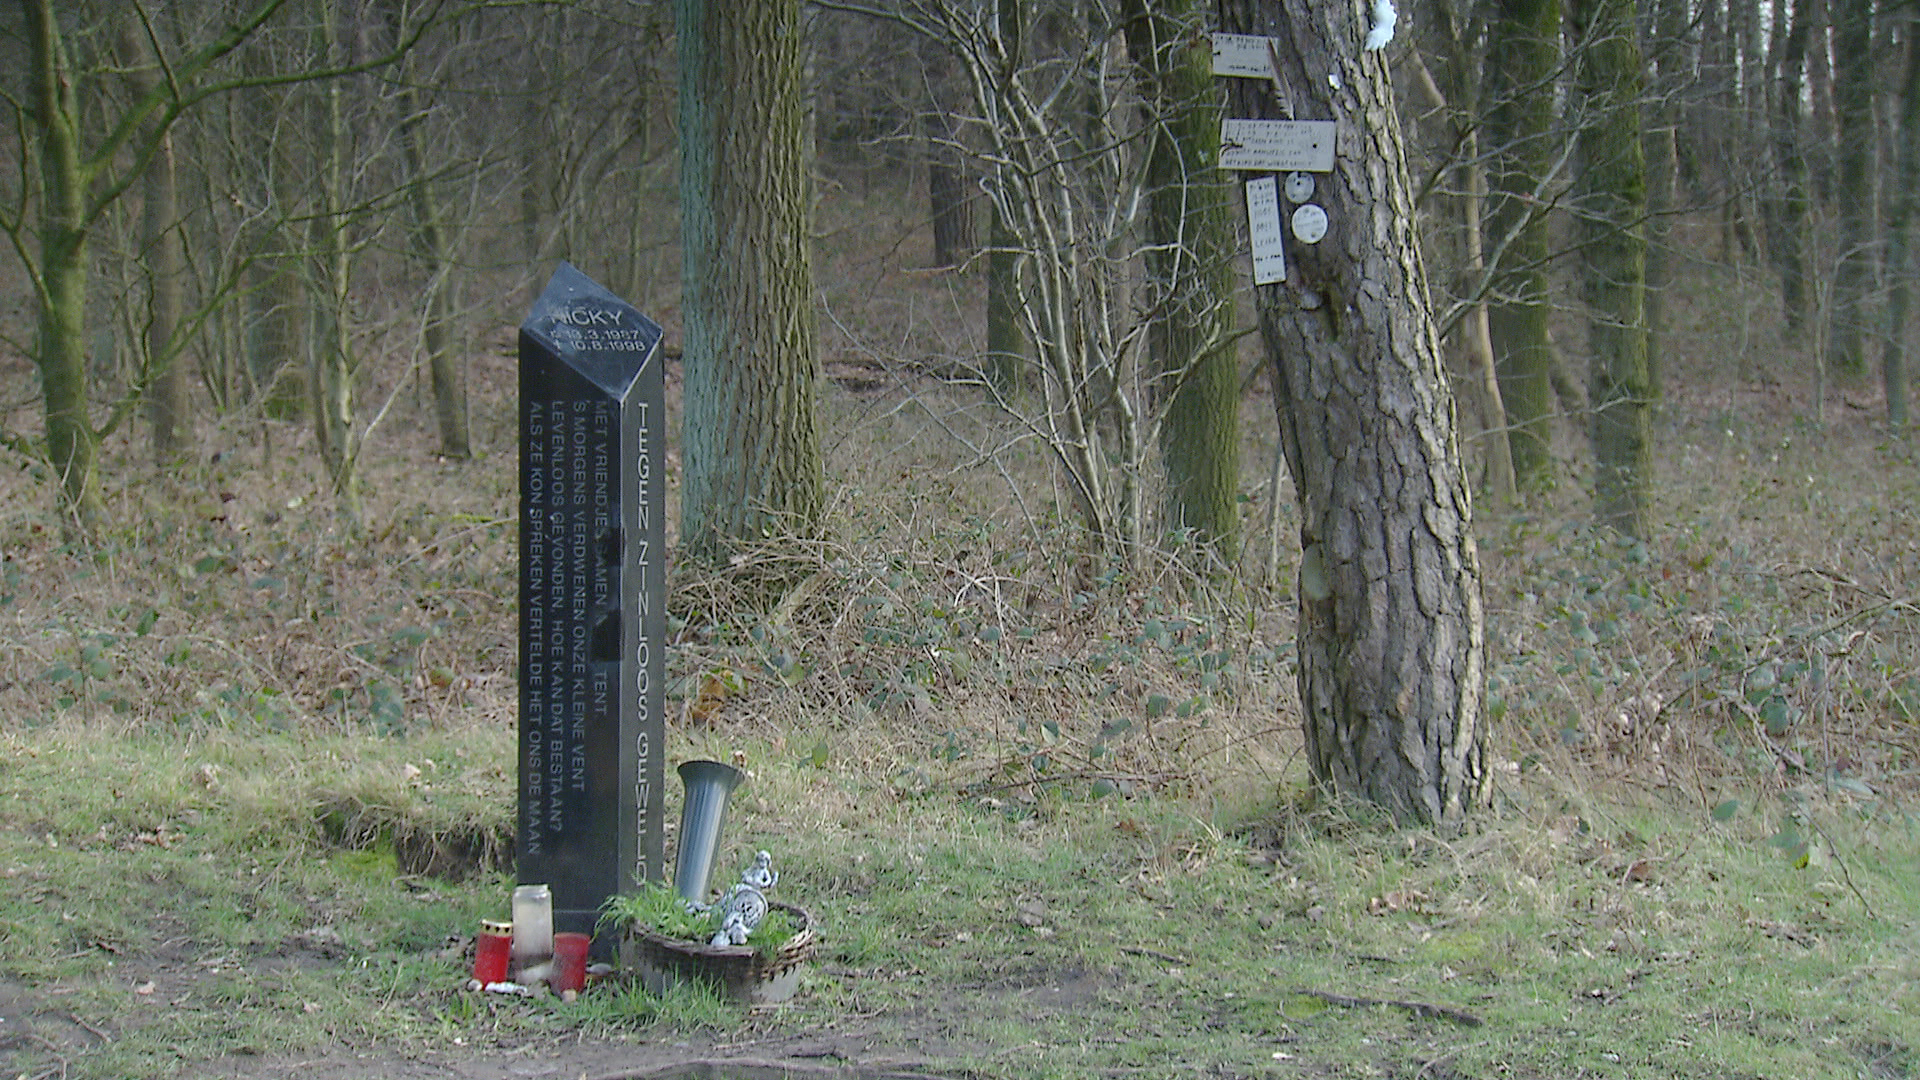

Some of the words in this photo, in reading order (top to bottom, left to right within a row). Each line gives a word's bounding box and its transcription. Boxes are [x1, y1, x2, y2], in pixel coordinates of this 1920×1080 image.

[551, 309, 622, 325] NICKY
[571, 340, 645, 351] 10.8.1998
[529, 401, 543, 435] ALS
[595, 400, 608, 437] MET
[529, 441, 543, 462] ZE
[551, 401, 565, 506] LEVENLOOS
[573, 417, 586, 505] MORGENS
[637, 402, 649, 529] TEGEN
[529, 467, 543, 504] KON
[529, 508, 543, 589] SPREKEN
[573, 511, 586, 621] VERDWENEN
[529, 595, 543, 686] VERTELDE
[551, 620, 565, 656] HOE
[573, 626, 586, 674] ONZE
[637, 539, 649, 721] ZINLOOS
[551, 661, 564, 699] KAN
[529, 690, 542, 725] HET
[551, 703, 564, 735] DAT
[572, 679, 586, 740] KLEINE
[529, 730, 542, 767] ONS
[572, 744, 585, 793] VENT
[528, 773, 541, 796] DE
[550, 740, 563, 831] BESTAAN?
[528, 800, 541, 855] MAAN
[635, 732, 650, 886] GEWELD
